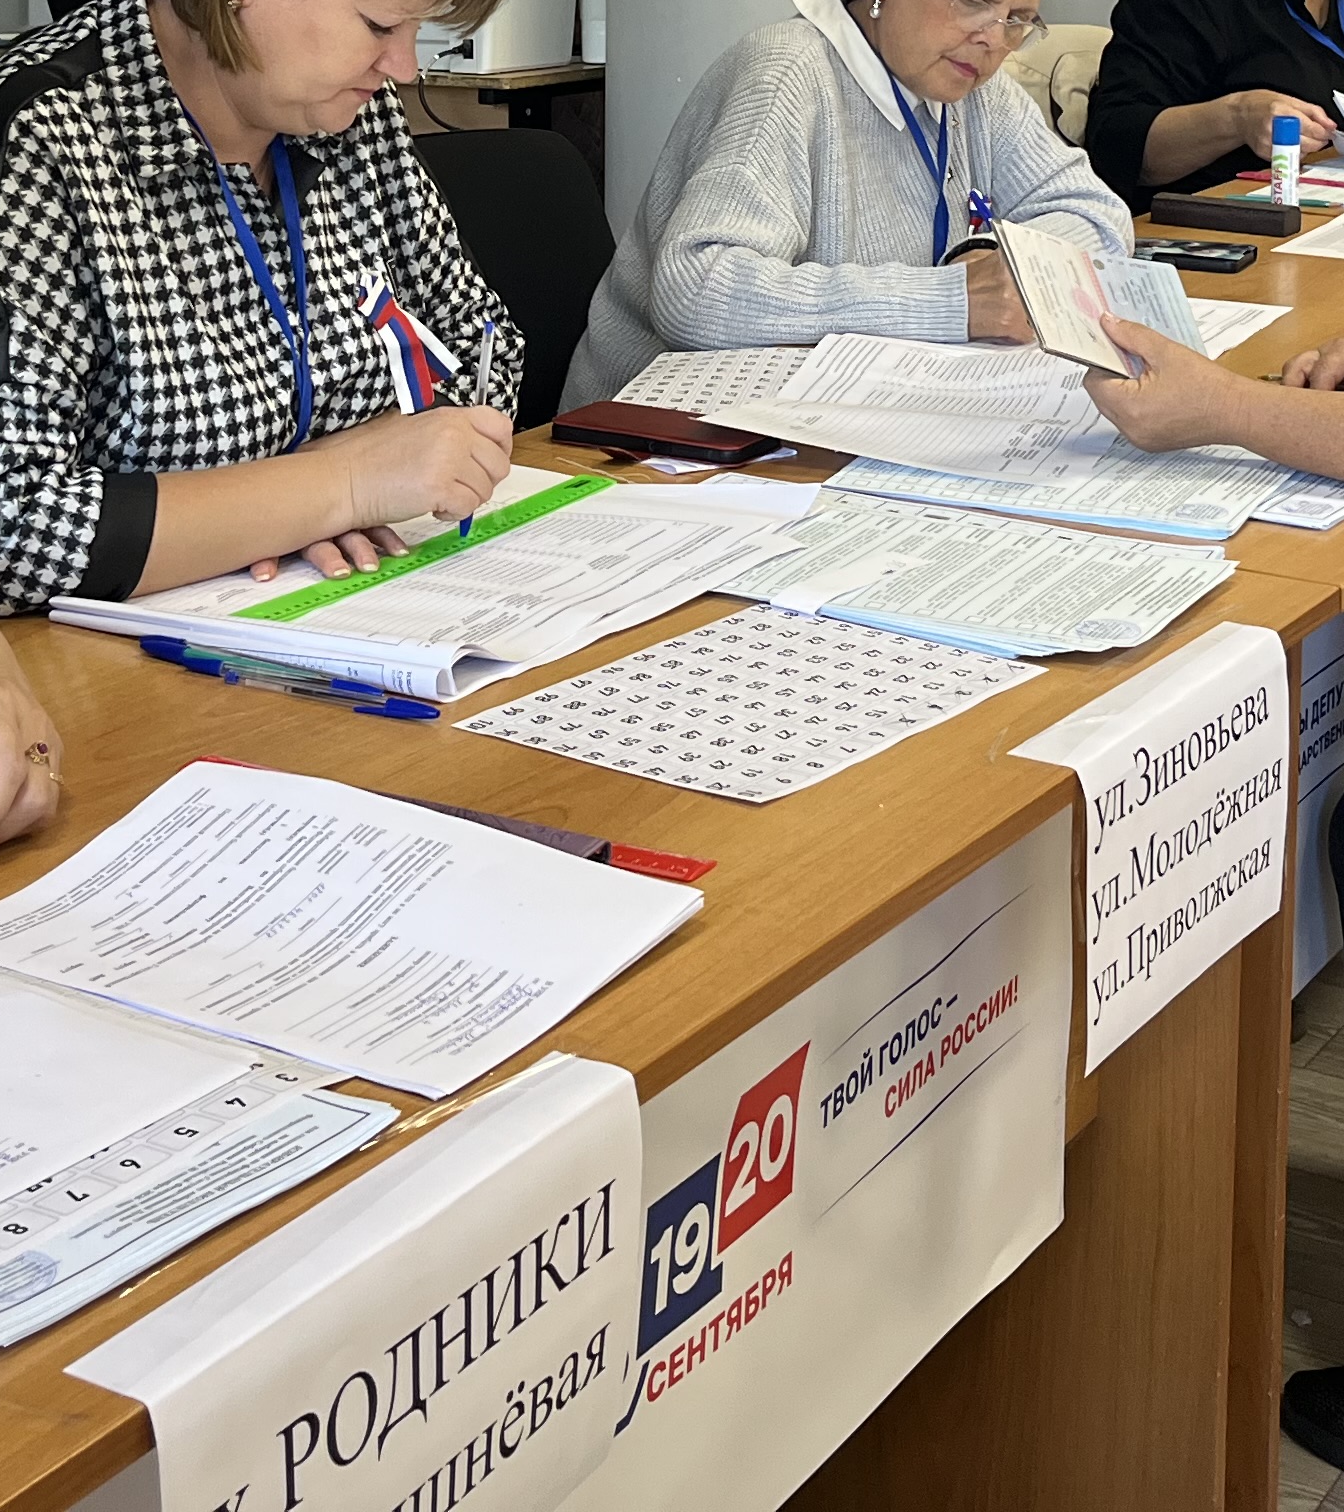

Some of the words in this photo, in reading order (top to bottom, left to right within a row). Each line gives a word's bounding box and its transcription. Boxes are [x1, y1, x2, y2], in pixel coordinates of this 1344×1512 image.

[1093, 686, 1269, 855] ул.Зиновьева
[1091, 757, 1283, 945] ул.Молодёжная
[1092, 837, 1272, 1026] ул.Приволжская
[225, 1095, 247, 1108] 4
[275, 1072, 298, 1083] 3
[820, 1050, 874, 1129] ТВОЙ
[878, 996, 943, 1073] ГОЛОС
[884, 1059, 936, 1119] СИЛА
[940, 974, 1020, 1070] РОССИИ!
[65, 1189, 90, 1203] 7
[119, 1159, 142, 1170] 6
[173, 1126, 199, 1138] 5
[2, 1223, 29, 1235] 8
[650, 1202, 712, 1316] 19
[724, 1094, 794, 1219] 20
[276, 1177, 617, 1512] РОДНИКИ
[646, 1250, 794, 1403] СЕНТЯБРЯ
